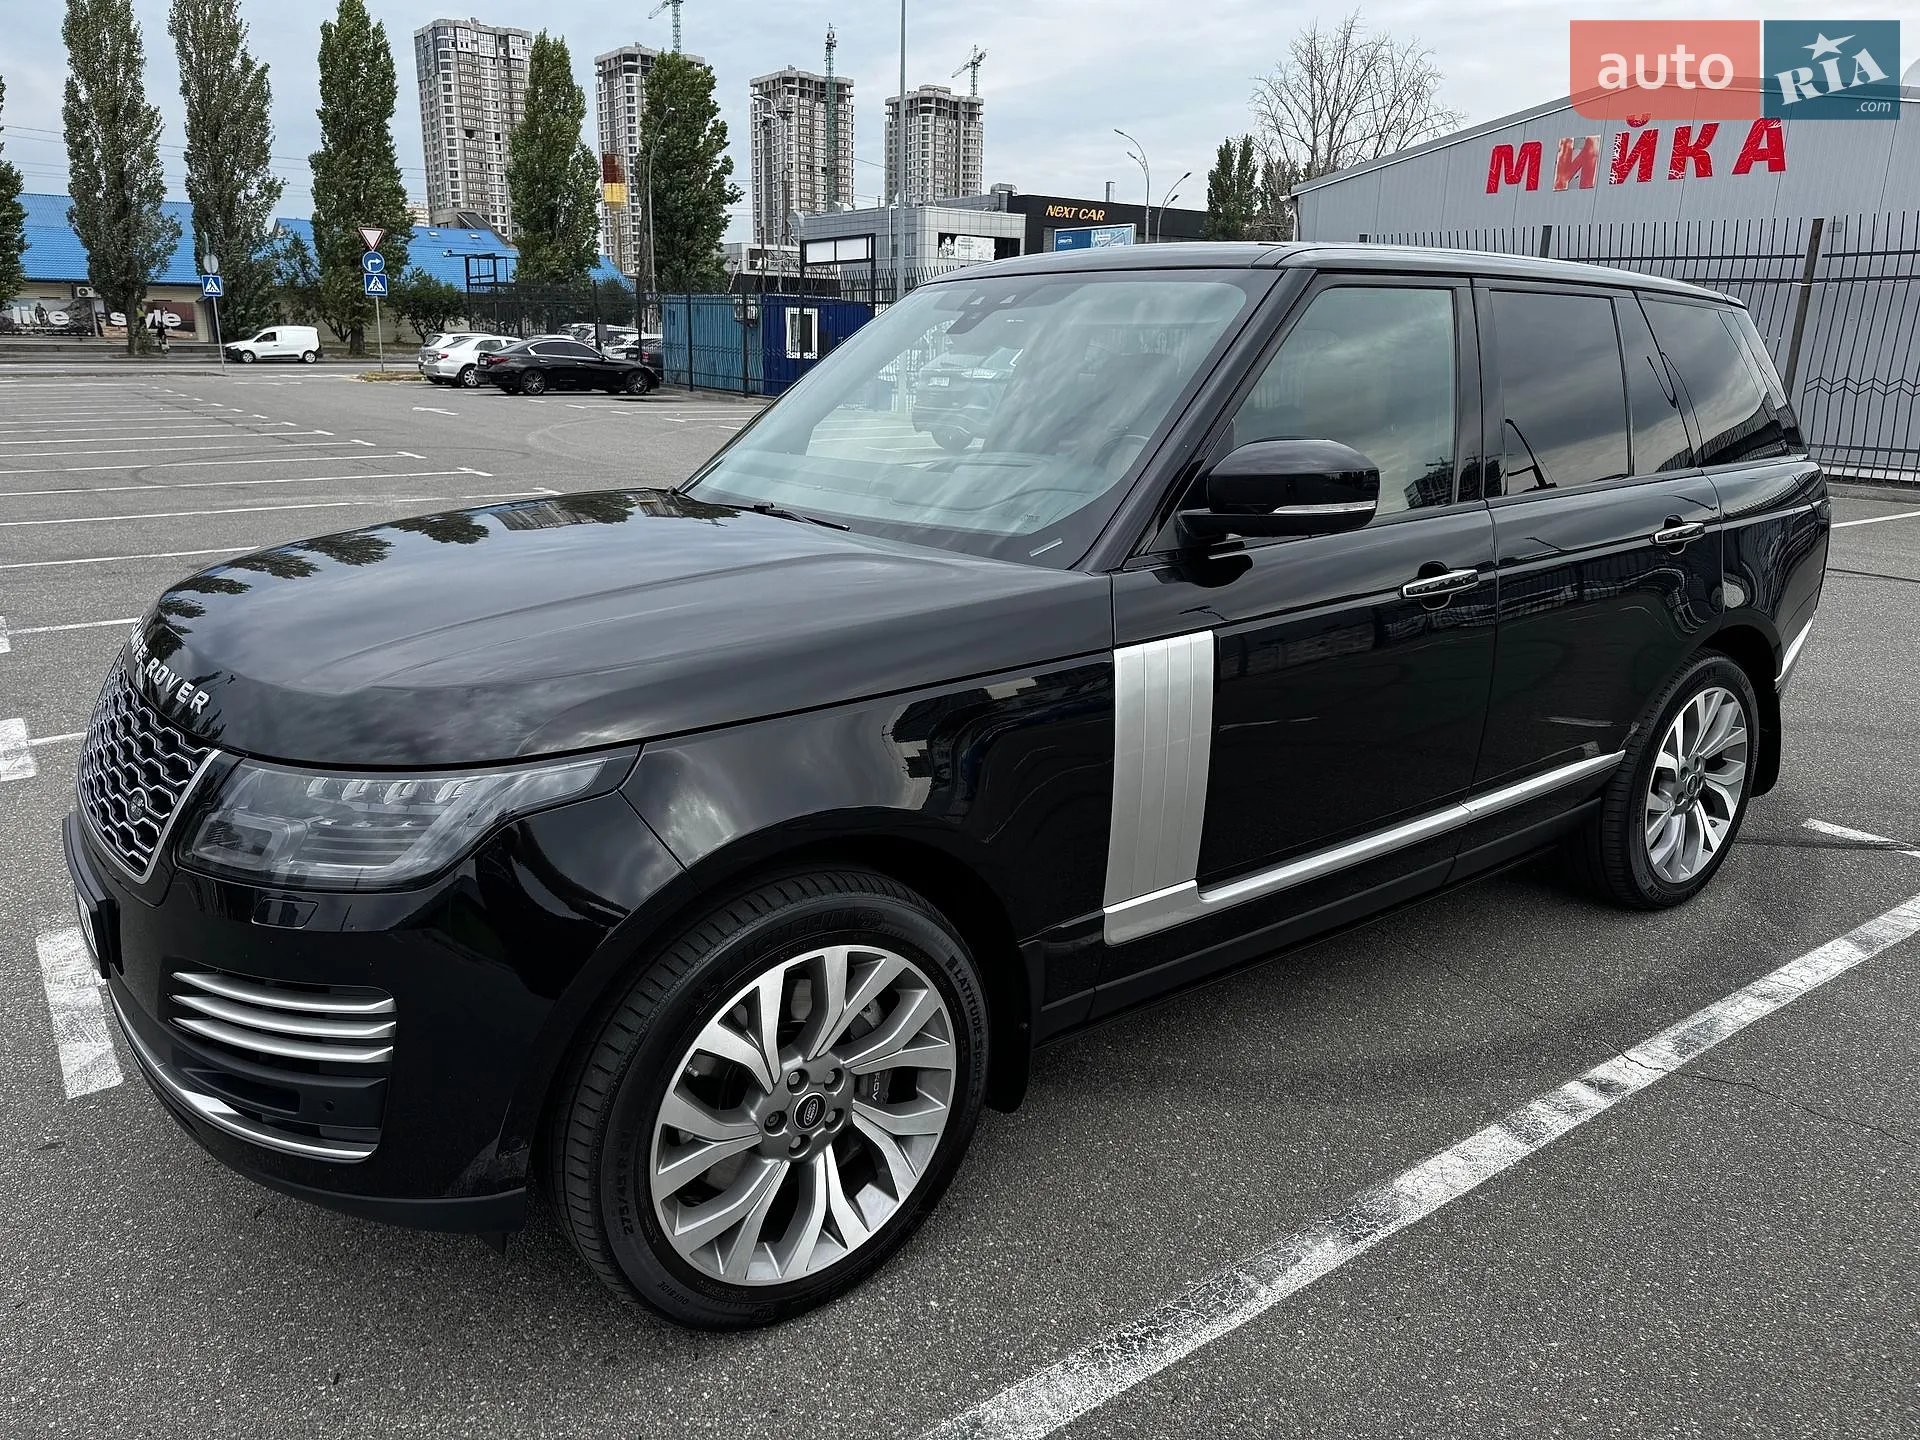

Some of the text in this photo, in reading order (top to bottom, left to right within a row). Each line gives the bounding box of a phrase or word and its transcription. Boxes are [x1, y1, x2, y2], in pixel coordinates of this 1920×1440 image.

[1485, 112, 1787, 194] МИЙКА
[1079, 208, 1106, 222] CAR
[12, 306, 182, 329] lie syle
[145, 657, 210, 715] ROVER
[952, 968, 982, 1037] LATITUDE
